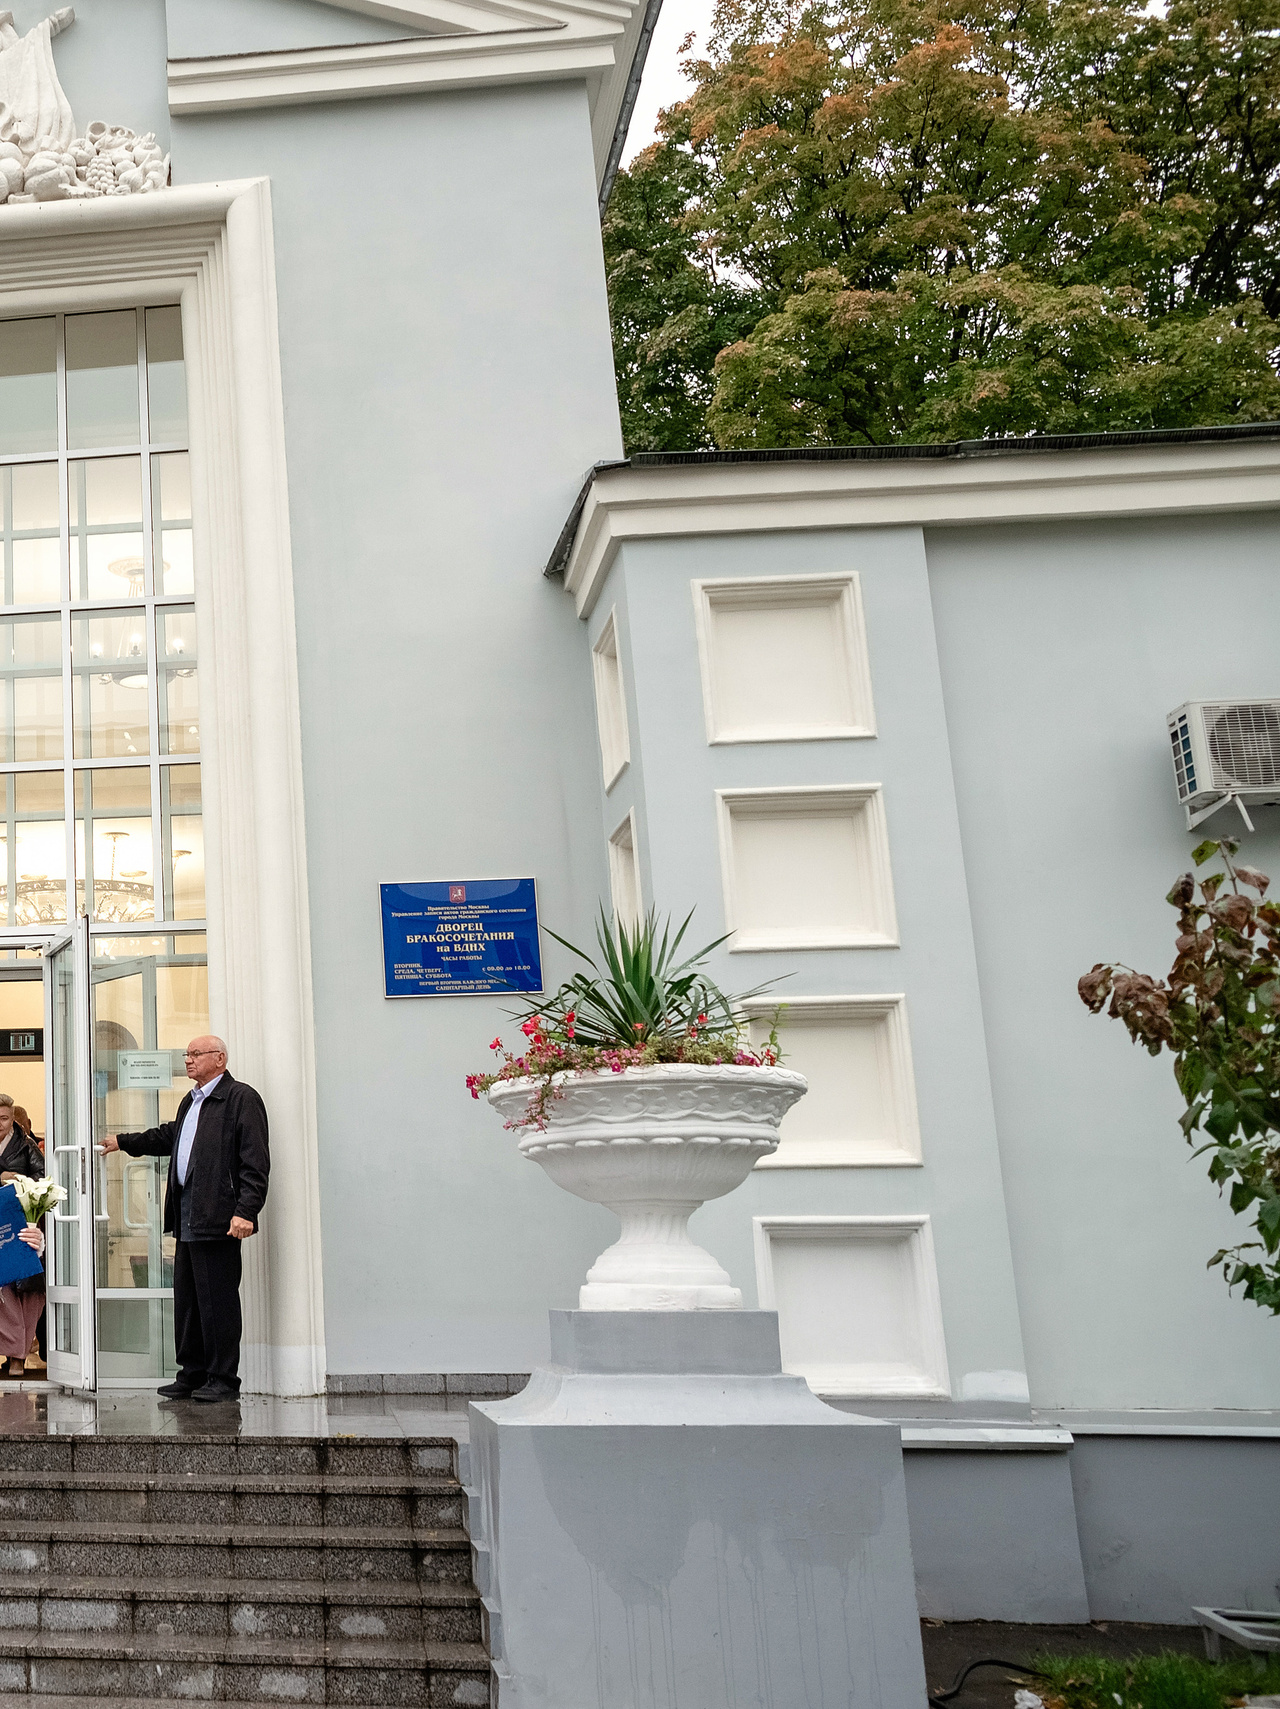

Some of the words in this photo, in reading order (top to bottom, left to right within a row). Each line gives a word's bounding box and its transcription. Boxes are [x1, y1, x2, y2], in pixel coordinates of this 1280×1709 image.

[435, 922, 484, 933] ДВОРЕЦ
[406, 932, 515, 943] БРАКОСОЧЕТАНИЯ
[453, 943, 486, 953] ВДНХ
